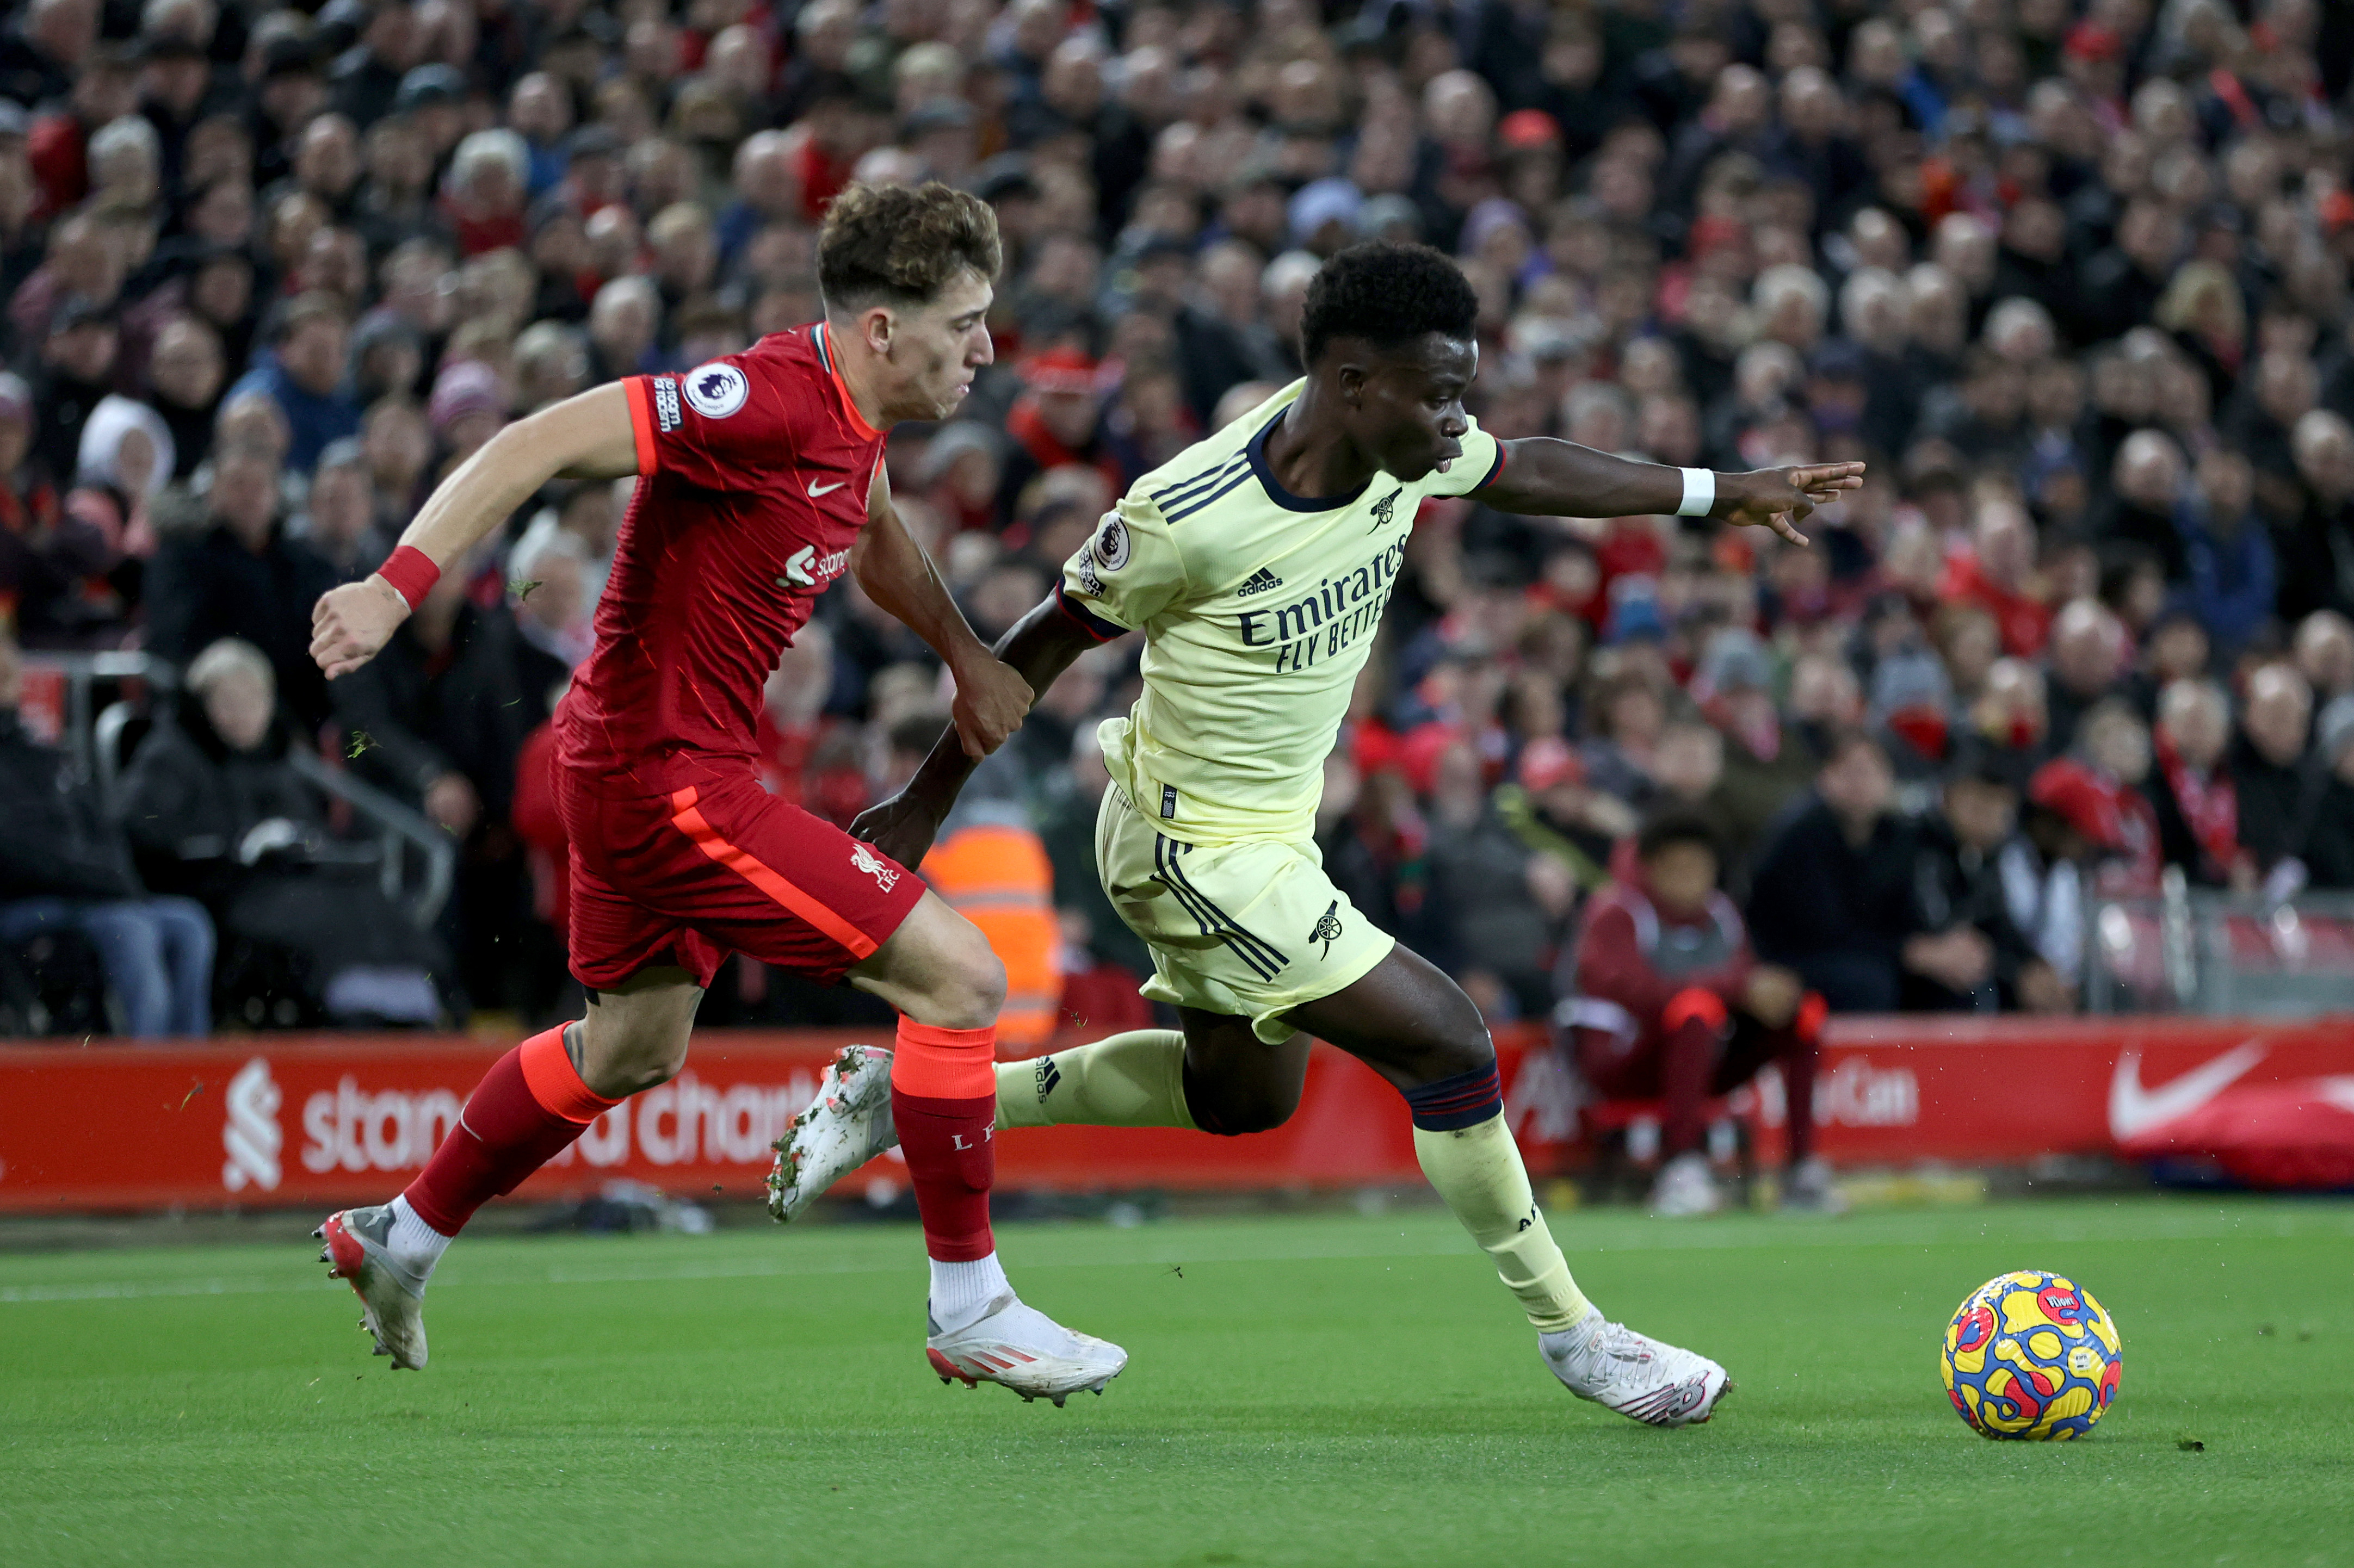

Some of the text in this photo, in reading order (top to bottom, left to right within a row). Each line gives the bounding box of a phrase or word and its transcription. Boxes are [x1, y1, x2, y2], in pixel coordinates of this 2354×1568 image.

[666, 391, 681, 425] room
[1086, 560, 1100, 590] room
[1237, 534, 1407, 646] Emirates
[1238, 578, 1283, 598] adidas
[1276, 631, 1320, 673] FLY
[1035, 1055, 1047, 1105] didas
[300, 1073, 632, 1173] stand
